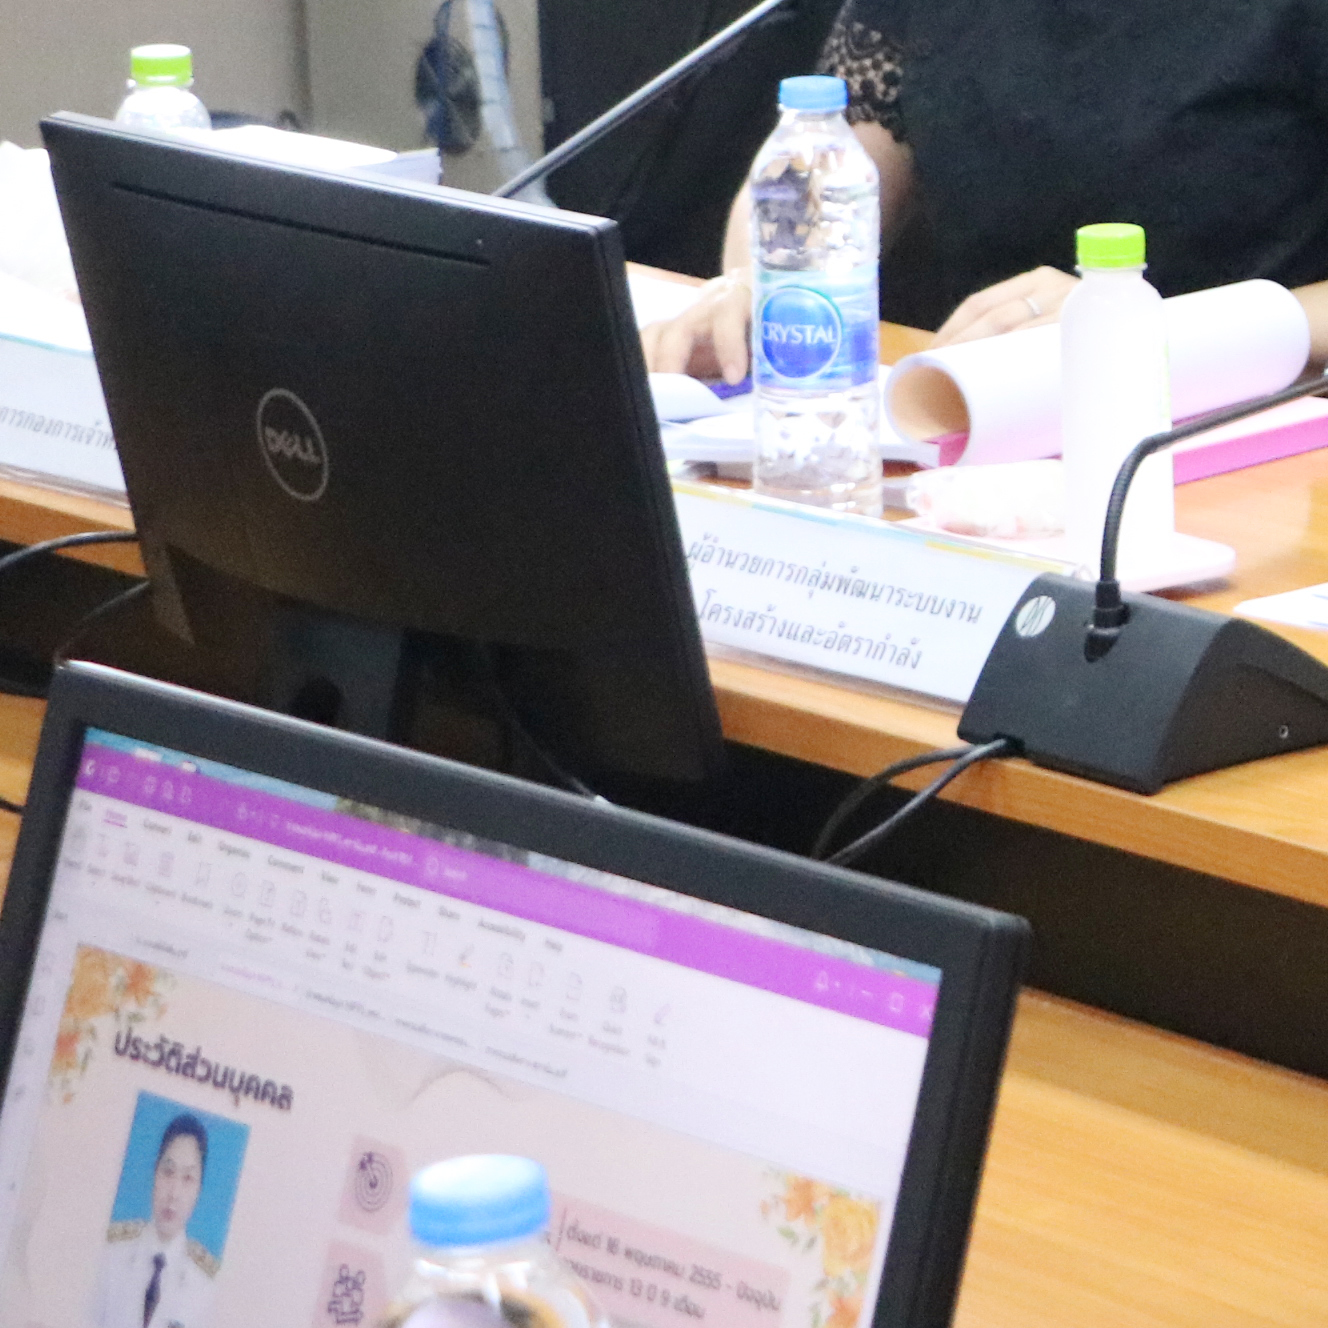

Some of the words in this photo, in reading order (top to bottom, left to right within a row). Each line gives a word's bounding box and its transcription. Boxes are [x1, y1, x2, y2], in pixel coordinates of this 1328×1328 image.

[762, 321, 838, 345] CRYSTAL
[265, 426, 323, 465] DELL
[687, 531, 983, 625] ผู้อำนวยการกลุ่มพัฒนาระบบงาน
[700, 587, 922, 670] โครงสร้างและอัตรากำลัง
[113, 1026, 294, 1112] ประวัติส่วนบุคคล
